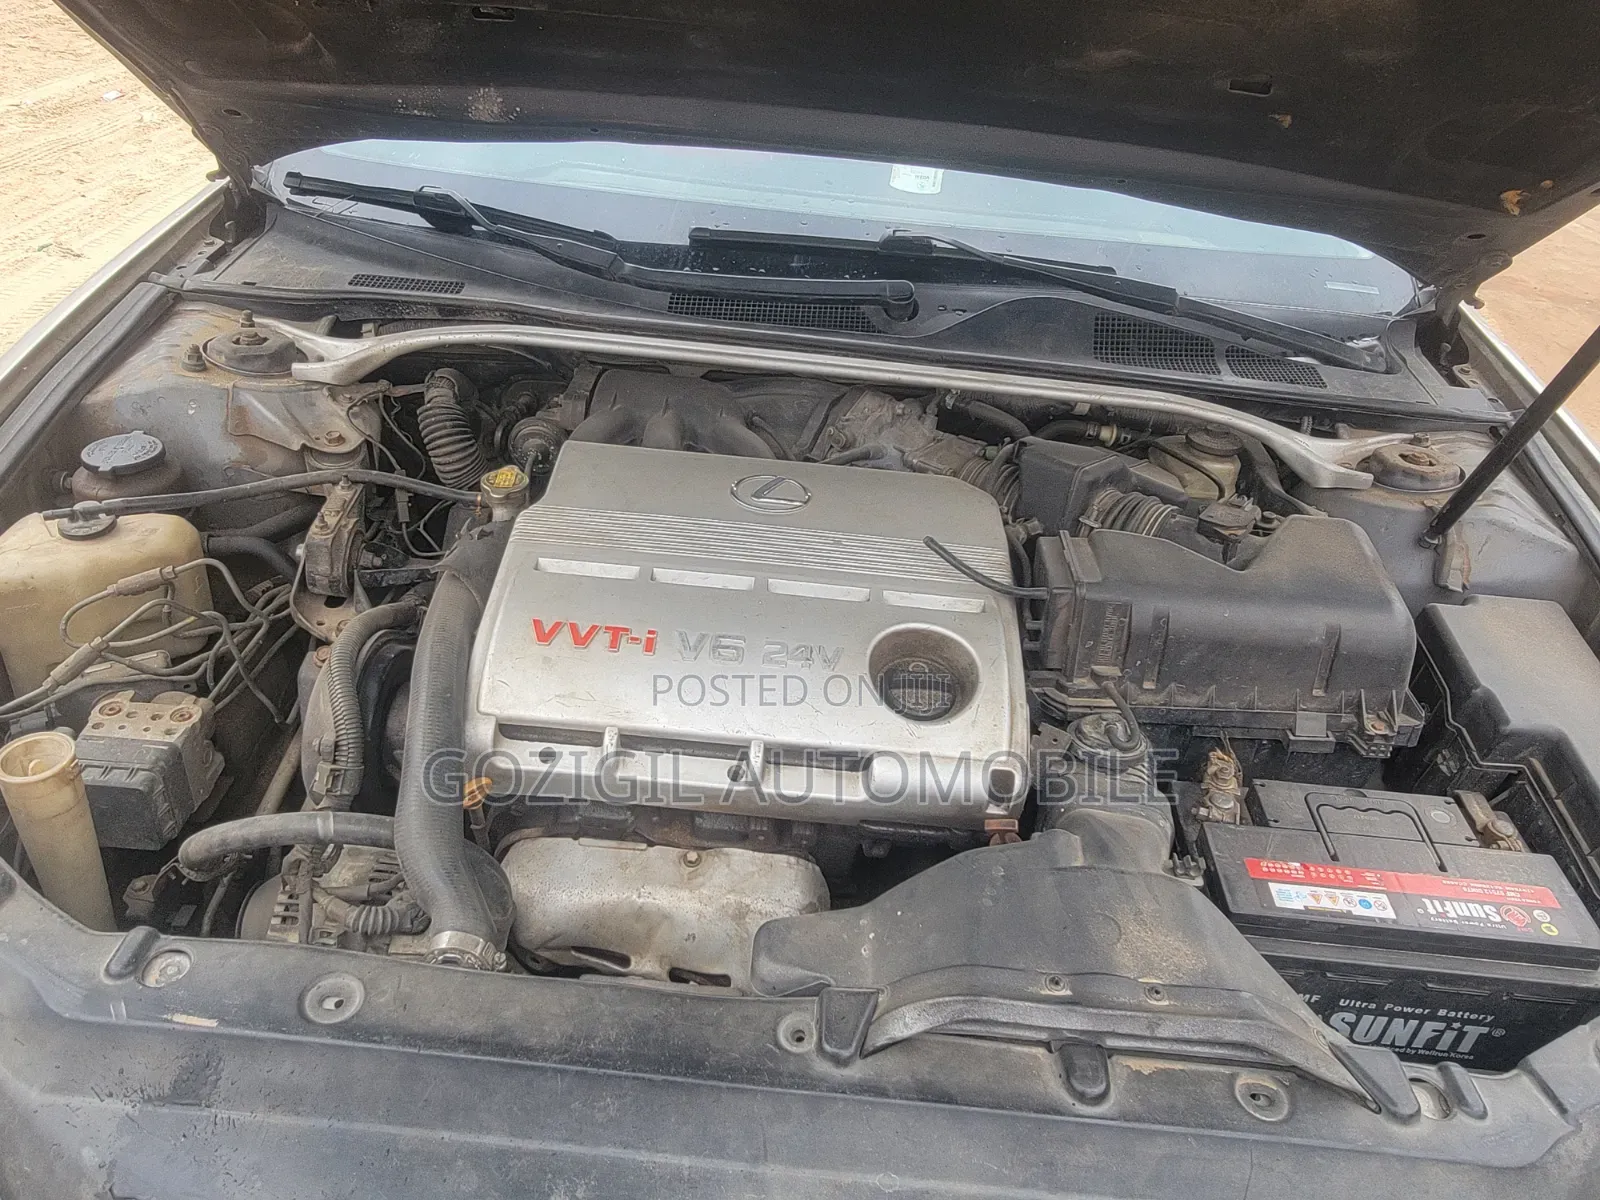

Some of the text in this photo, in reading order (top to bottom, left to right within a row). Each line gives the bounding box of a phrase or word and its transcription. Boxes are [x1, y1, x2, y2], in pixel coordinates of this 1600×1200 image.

[531, 617, 845, 673] VVT-i V6 24V
[1338, 998, 1496, 1024] Ultra Power Battery
